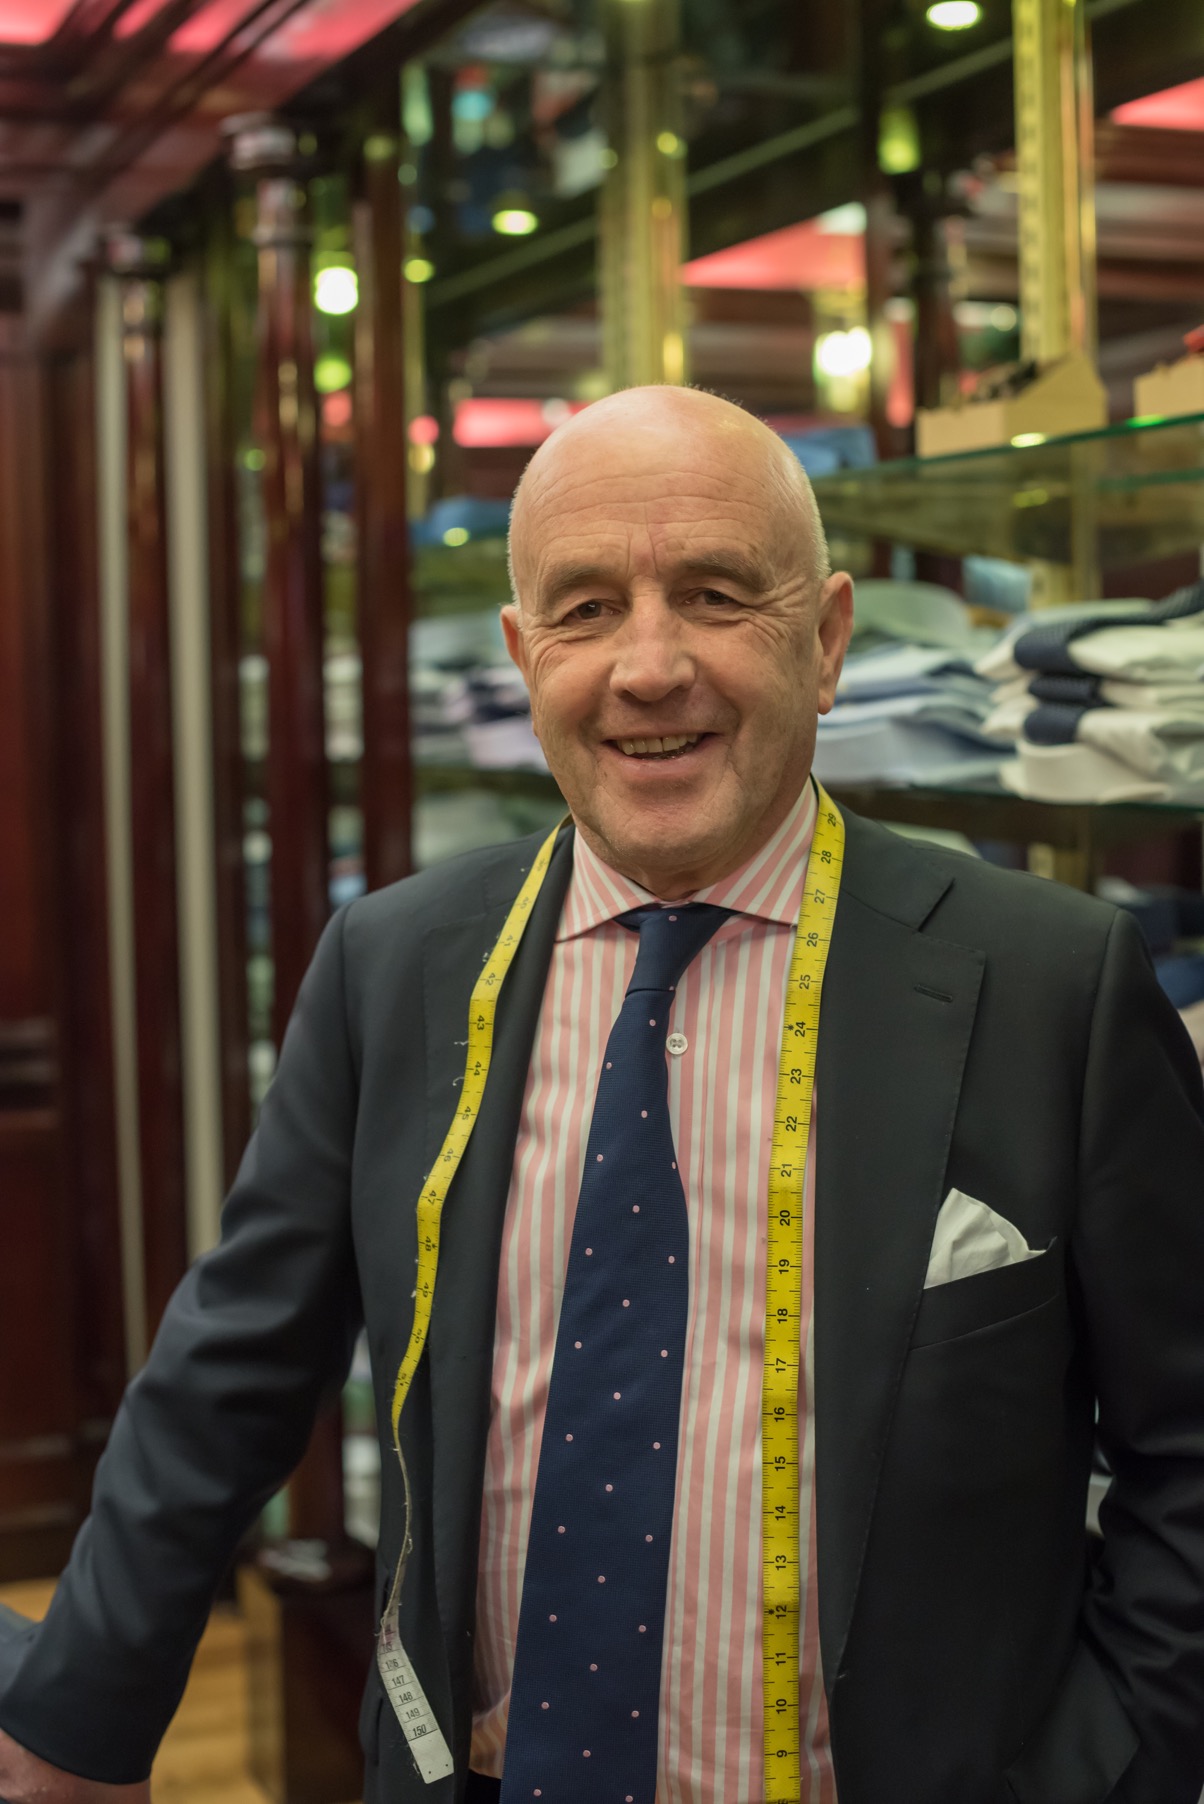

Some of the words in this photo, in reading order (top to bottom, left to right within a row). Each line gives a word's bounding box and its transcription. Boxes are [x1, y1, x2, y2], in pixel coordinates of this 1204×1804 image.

[827, 812, 837, 827] 29
[820, 850, 832, 864] 28
[814, 888, 826, 904] 27
[806, 932, 819, 947] 26
[485, 972, 496, 986] 42
[798, 974, 811, 990] 25
[476, 1014, 485, 1032] 43
[794, 1021, 806, 1038] 24
[473, 1060, 482, 1076] 44
[789, 1068, 802, 1085] 23
[461, 1105, 471, 1120] 45
[785, 1115, 798, 1132] 22
[443, 1147, 454, 1162] 46
[780, 1163, 792, 1178] 21
[427, 1189, 437, 1206] 47
[779, 1209, 791, 1226] 20
[424, 1235, 432, 1252] 48
[778, 1258, 790, 1274] 19
[422, 1281, 430, 1298] 49
[776, 1308, 788, 1324] 18
[775, 1357, 787, 1373] 17
[773, 1406, 785, 1422] 16
[774, 1456, 786, 1472] 15
[774, 1505, 786, 1521] 14
[775, 1554, 787, 1571] 13
[775, 1604, 787, 1620] 12
[775, 1652, 787, 1666] 11
[391, 1674, 405, 1687] 147
[398, 1691, 414, 1703] 148
[405, 1707, 420, 1720] 149
[775, 1698, 787, 1714] 10
[412, 1723, 427, 1737] 150
[776, 1749, 788, 1758] 9
